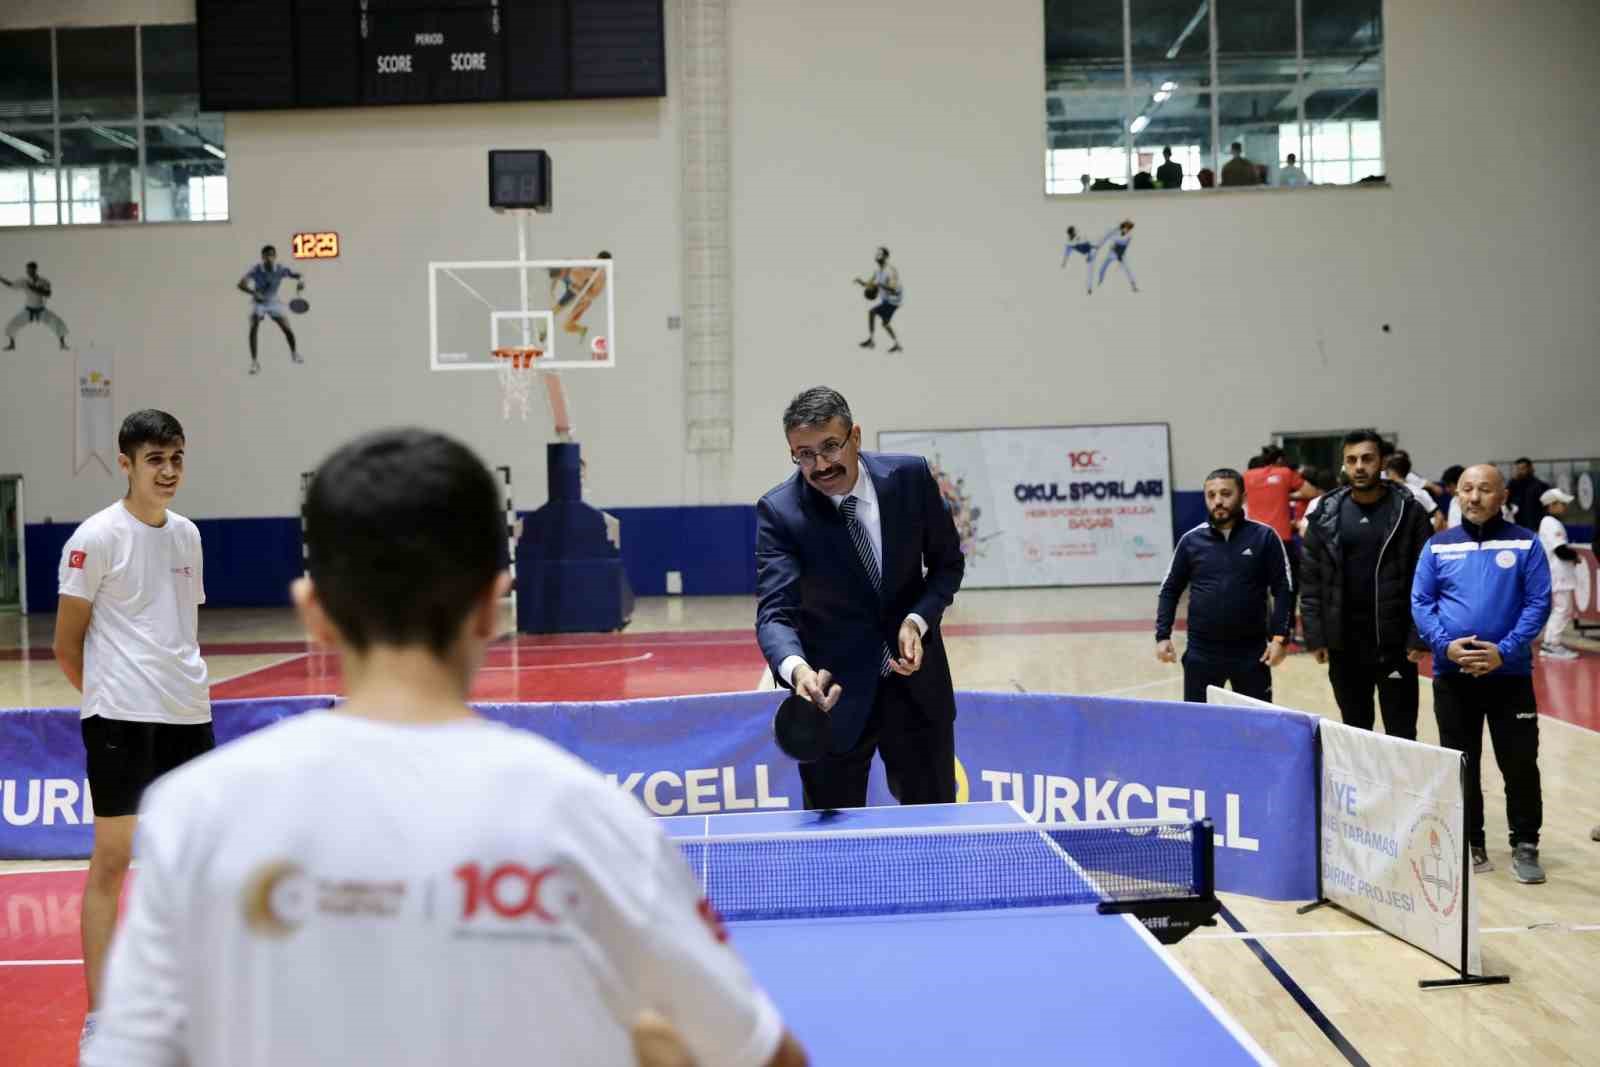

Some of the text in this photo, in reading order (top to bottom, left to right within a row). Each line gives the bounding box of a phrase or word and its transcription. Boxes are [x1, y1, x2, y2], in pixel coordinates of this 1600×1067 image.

[415, 33, 443, 45] PERIOD
[377, 53, 486, 73] SCORE SCORE
[1014, 479, 1164, 502] OKUL SPORLARI
[981, 770, 1259, 851] TURKCELL
